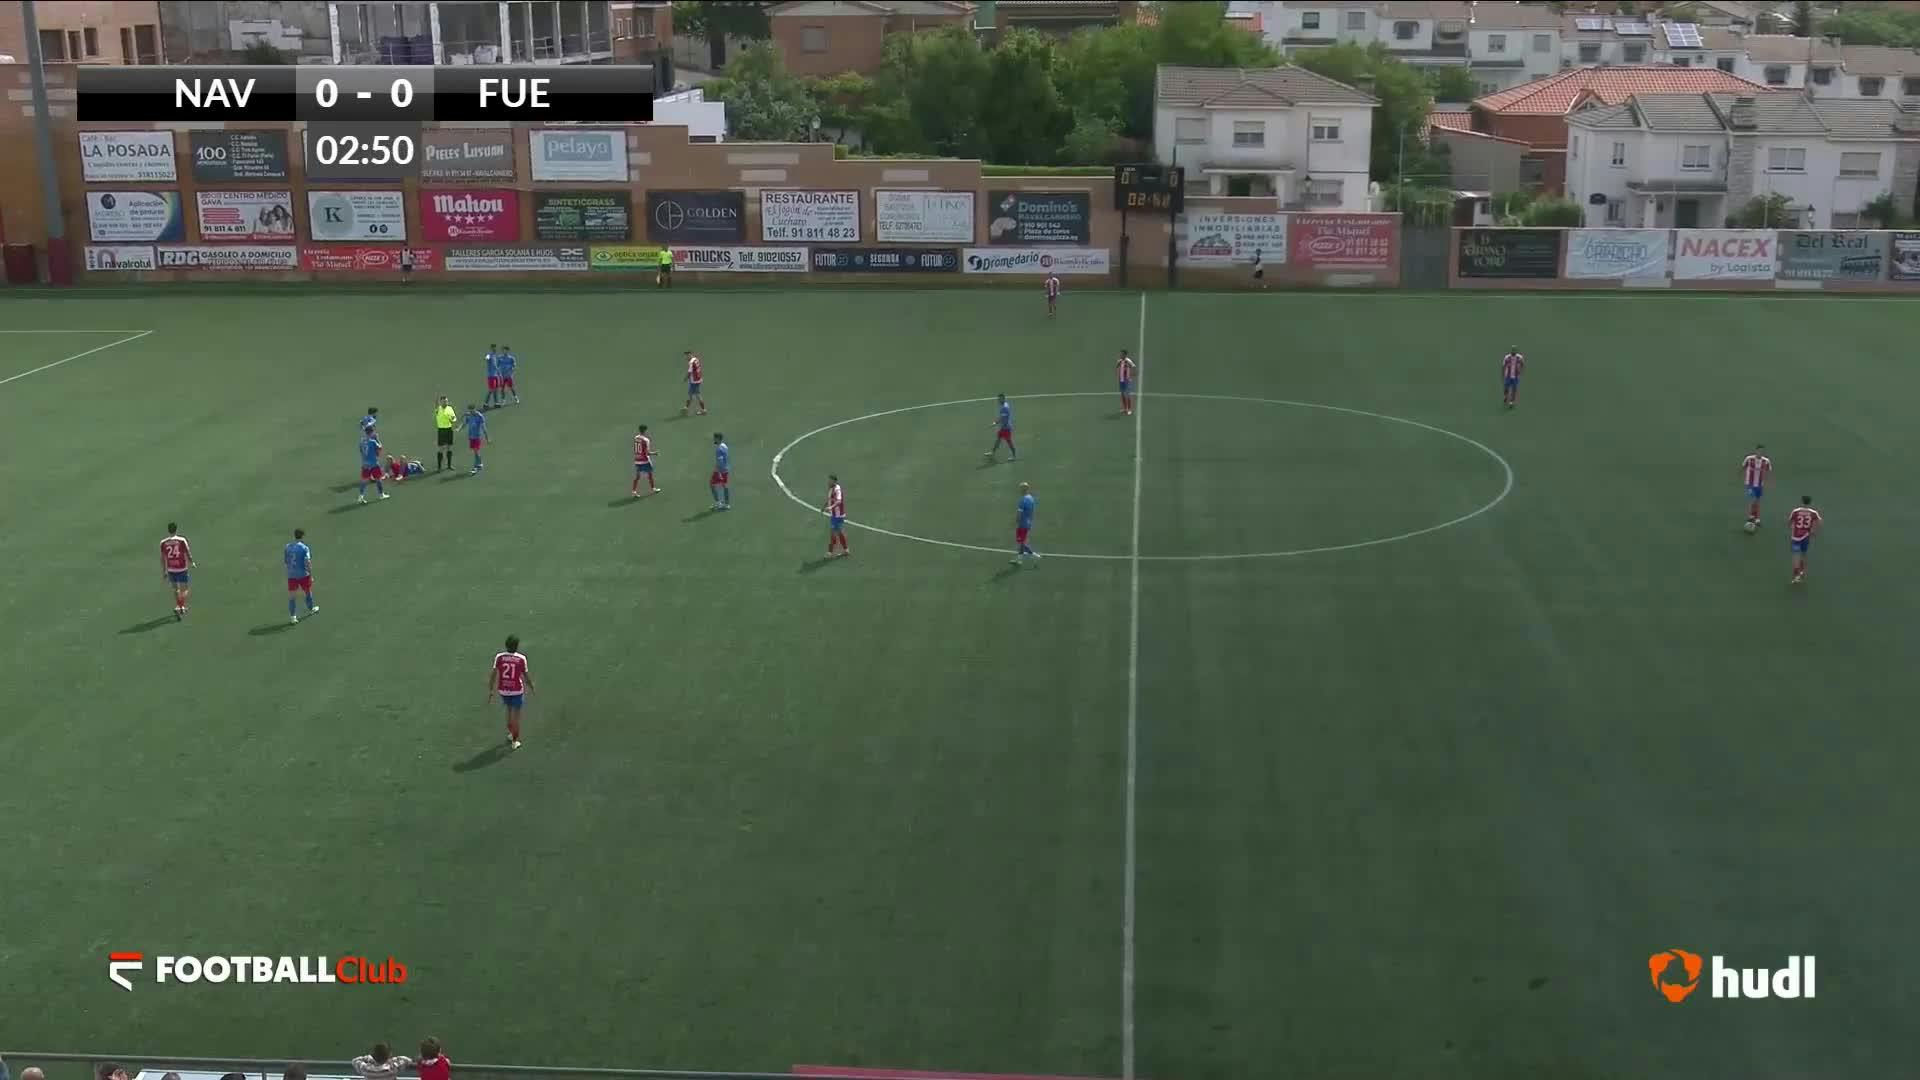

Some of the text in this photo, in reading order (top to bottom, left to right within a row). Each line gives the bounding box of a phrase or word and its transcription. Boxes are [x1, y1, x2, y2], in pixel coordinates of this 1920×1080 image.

[83, 144, 171, 158] LA POSADA
[196, 147, 227, 161] 100
[425, 145, 460, 161] PIELES
[547, 136, 608, 159] pelayo
[223, 192, 255, 200] CENTRO
[433, 193, 504, 213] Mahou
[765, 193, 854, 204] RESTAURANTE
[687, 207, 737, 218] GOLDEN
[1018, 200, 1079, 213] Domino's
[324, 207, 345, 223] K
[767, 227, 855, 239] Telf. 91 811 48 23
[451, 249, 481, 257] TALLERES
[504, 249, 530, 257] SOLANA
[1680, 238, 1770, 257] NACEX
[163, 250, 199, 266] RDG
[201, 251, 292, 259] GASOLEO A DOMICILIO
[757, 251, 802, 263] 910210557
[982, 251, 1040, 271] Dromedario
[1710, 262, 1771, 273] by Logista
[1795, 515, 1812, 529] 33
[166, 545, 181, 559] 24
[502, 662, 516, 680] 21
